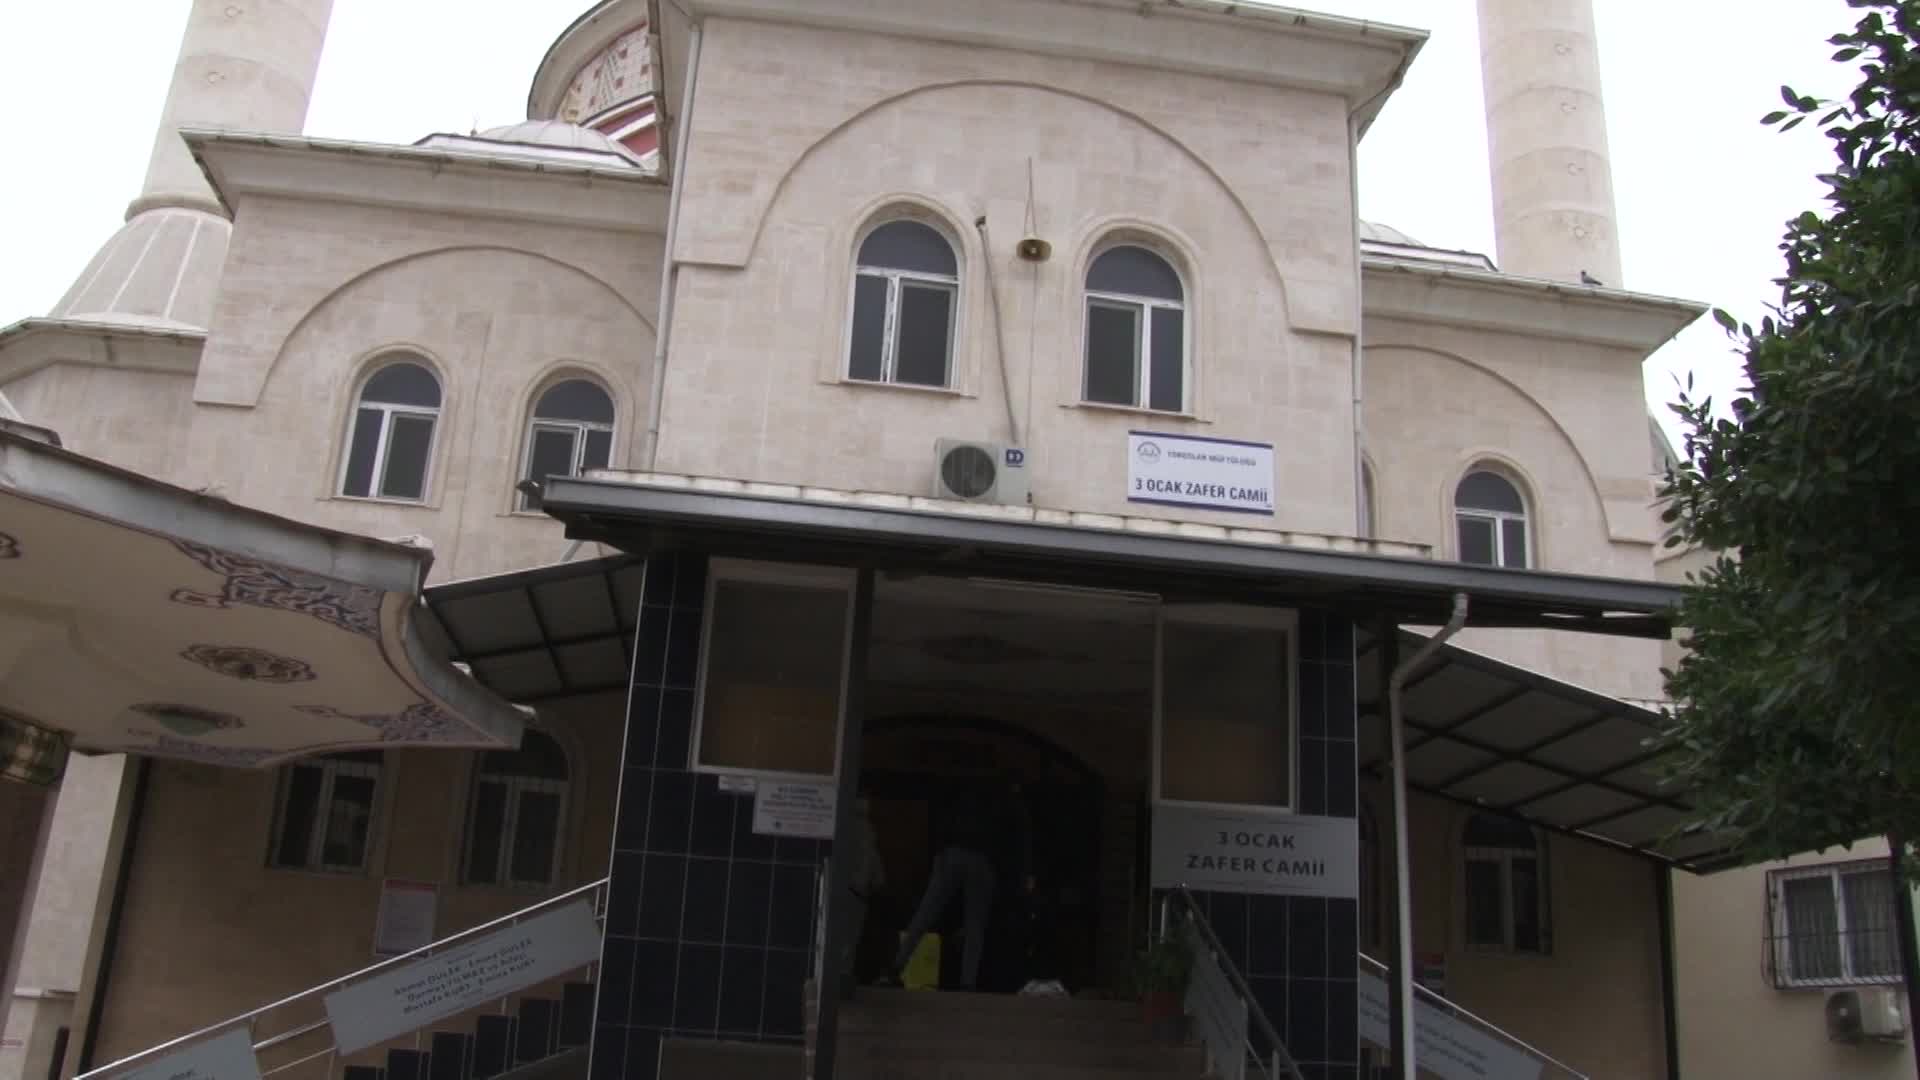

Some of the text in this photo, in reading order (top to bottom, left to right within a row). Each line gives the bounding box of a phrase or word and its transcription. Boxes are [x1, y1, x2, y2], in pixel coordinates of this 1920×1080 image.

[1136, 477, 1142, 490] 3
[1146, 478, 1182, 494] OCAK
[1185, 481, 1225, 498] ZAFER
[1217, 831, 1297, 850] 3 OCAK
[1186, 853, 1257, 873] ZAFER
